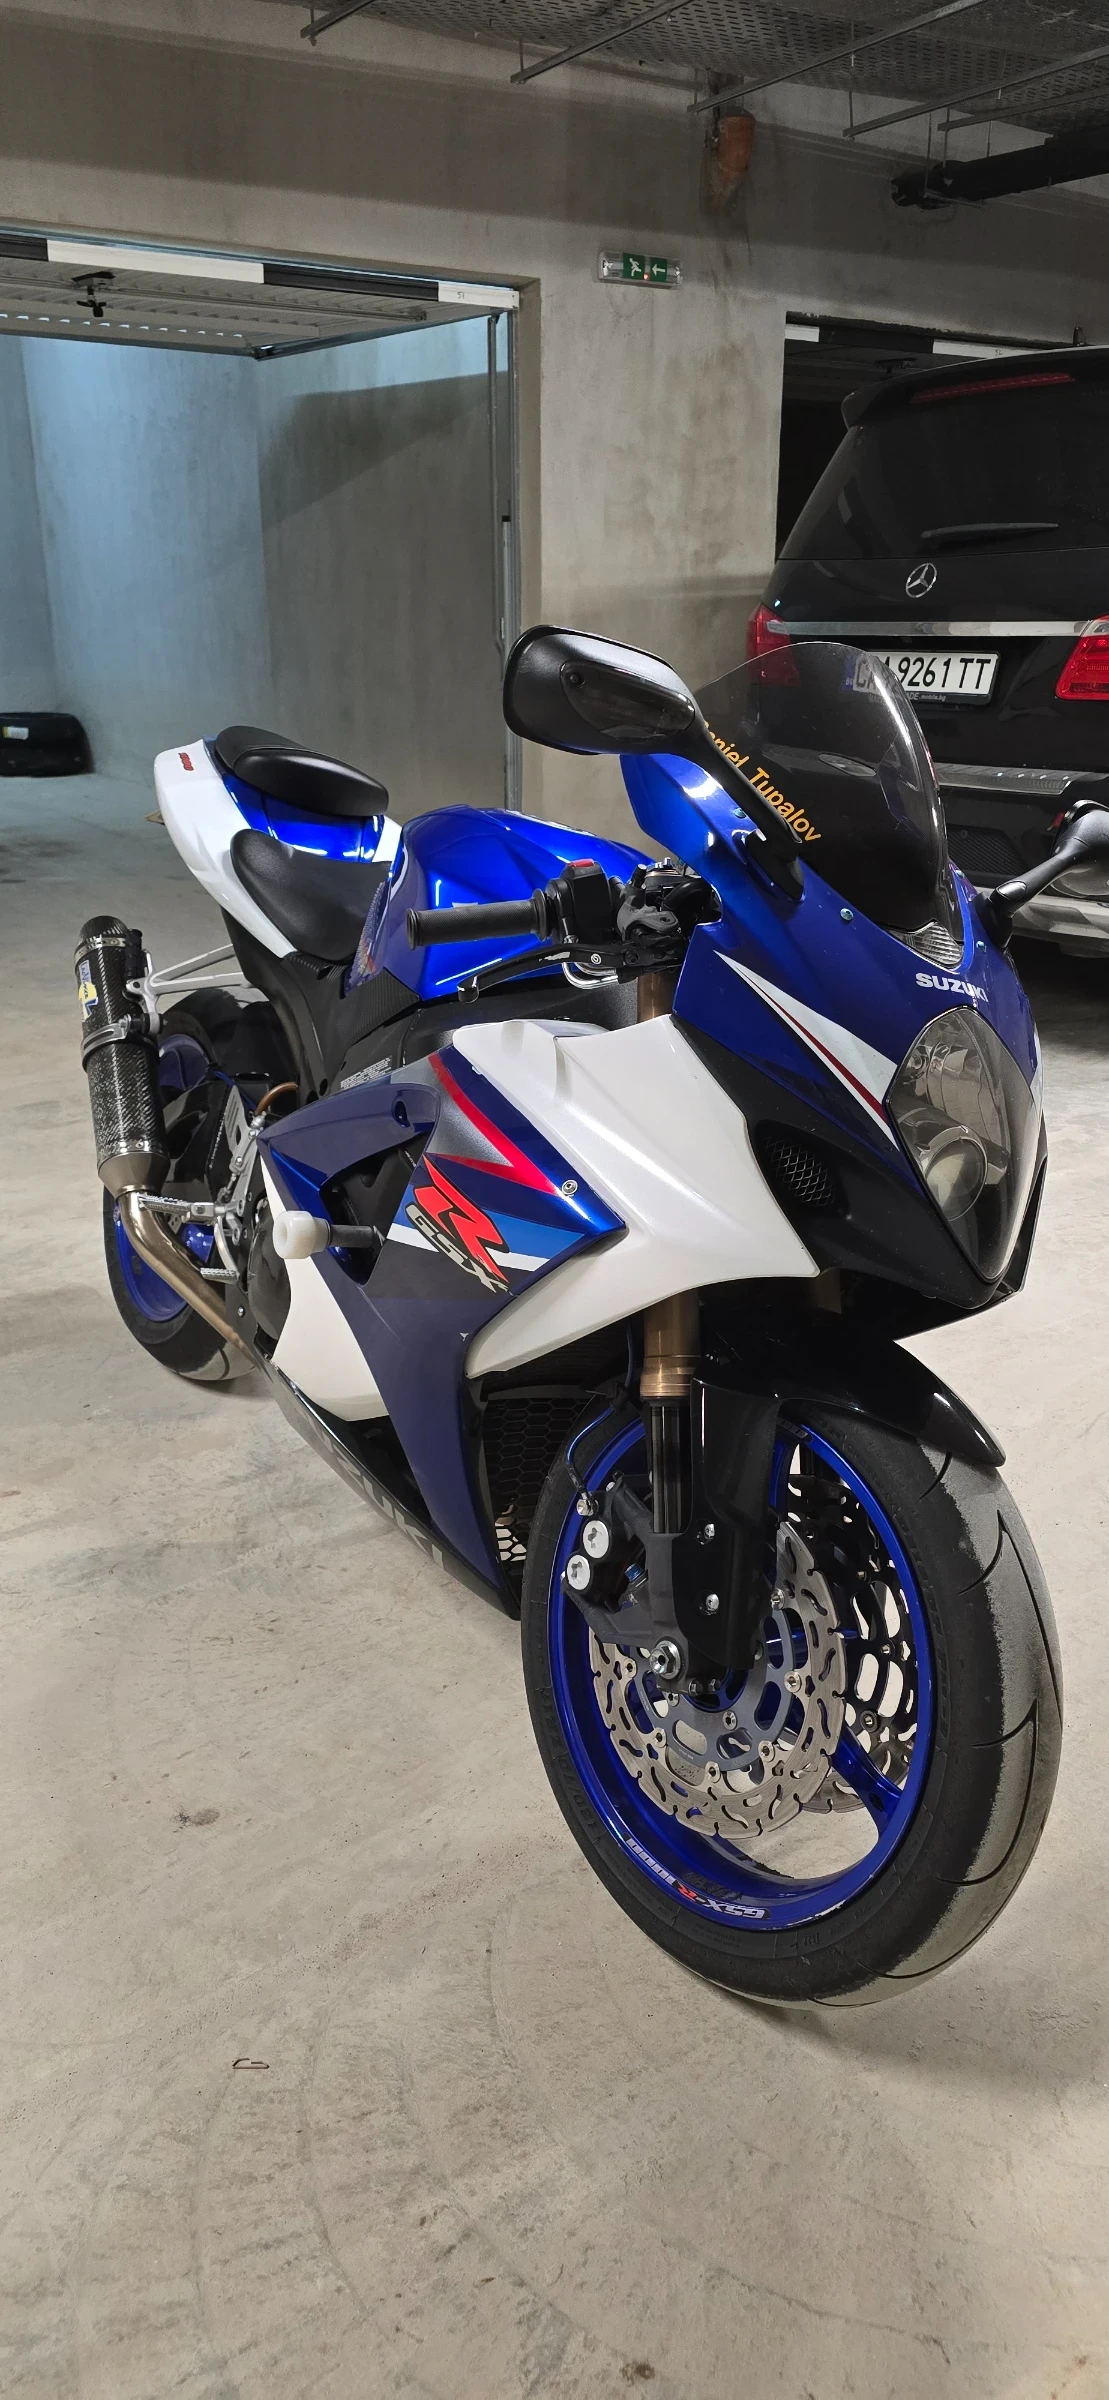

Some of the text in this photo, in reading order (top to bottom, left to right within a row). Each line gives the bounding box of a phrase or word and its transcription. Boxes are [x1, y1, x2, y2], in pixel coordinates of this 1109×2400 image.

[898, 656, 952, 688] 9261
[959, 657, 992, 690] TT
[749, 766, 822, 842] Tupalov
[915, 972, 989, 1003] SUZUKI
[626, 1837, 677, 1886] 1000
[678, 1882, 766, 1919] GSX-R
